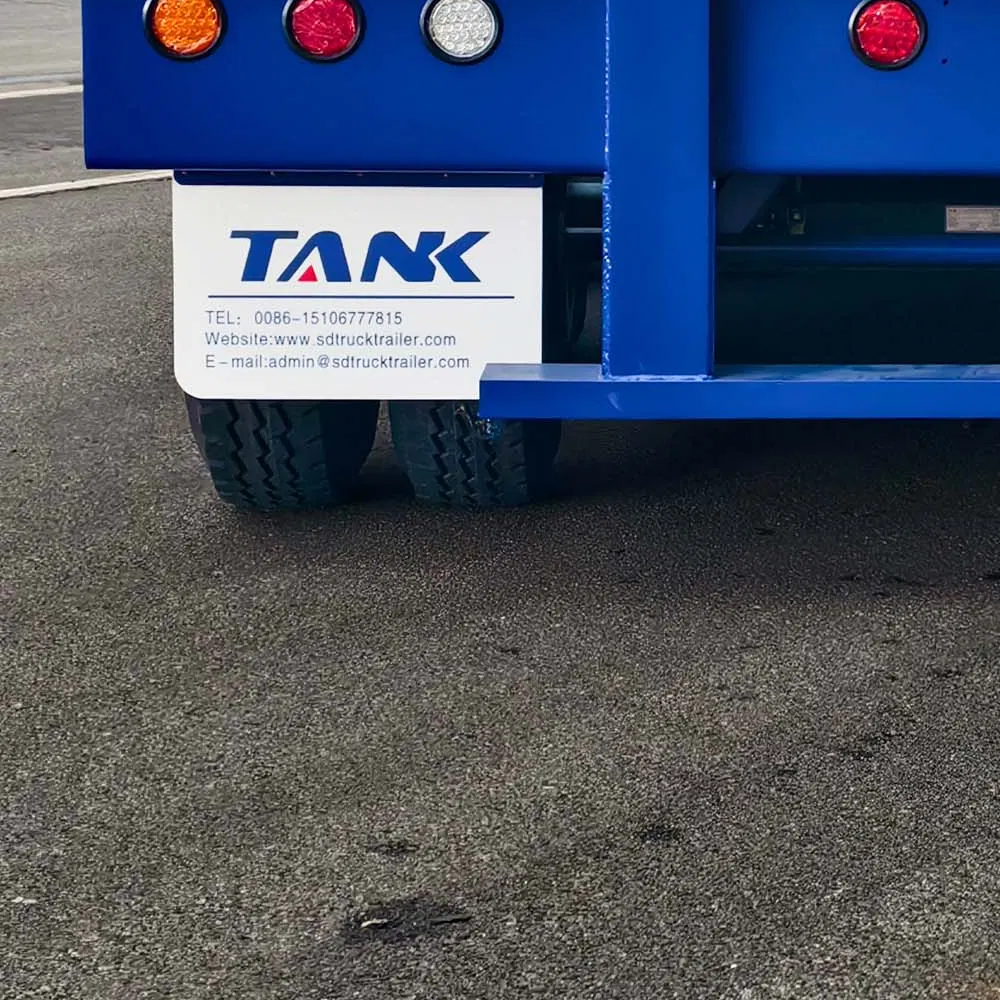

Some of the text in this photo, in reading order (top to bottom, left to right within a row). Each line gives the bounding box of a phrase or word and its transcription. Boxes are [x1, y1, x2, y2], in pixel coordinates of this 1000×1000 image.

[230, 230, 490, 282] TANK
[205, 310, 403, 326] TEL: 0086-15106777815
